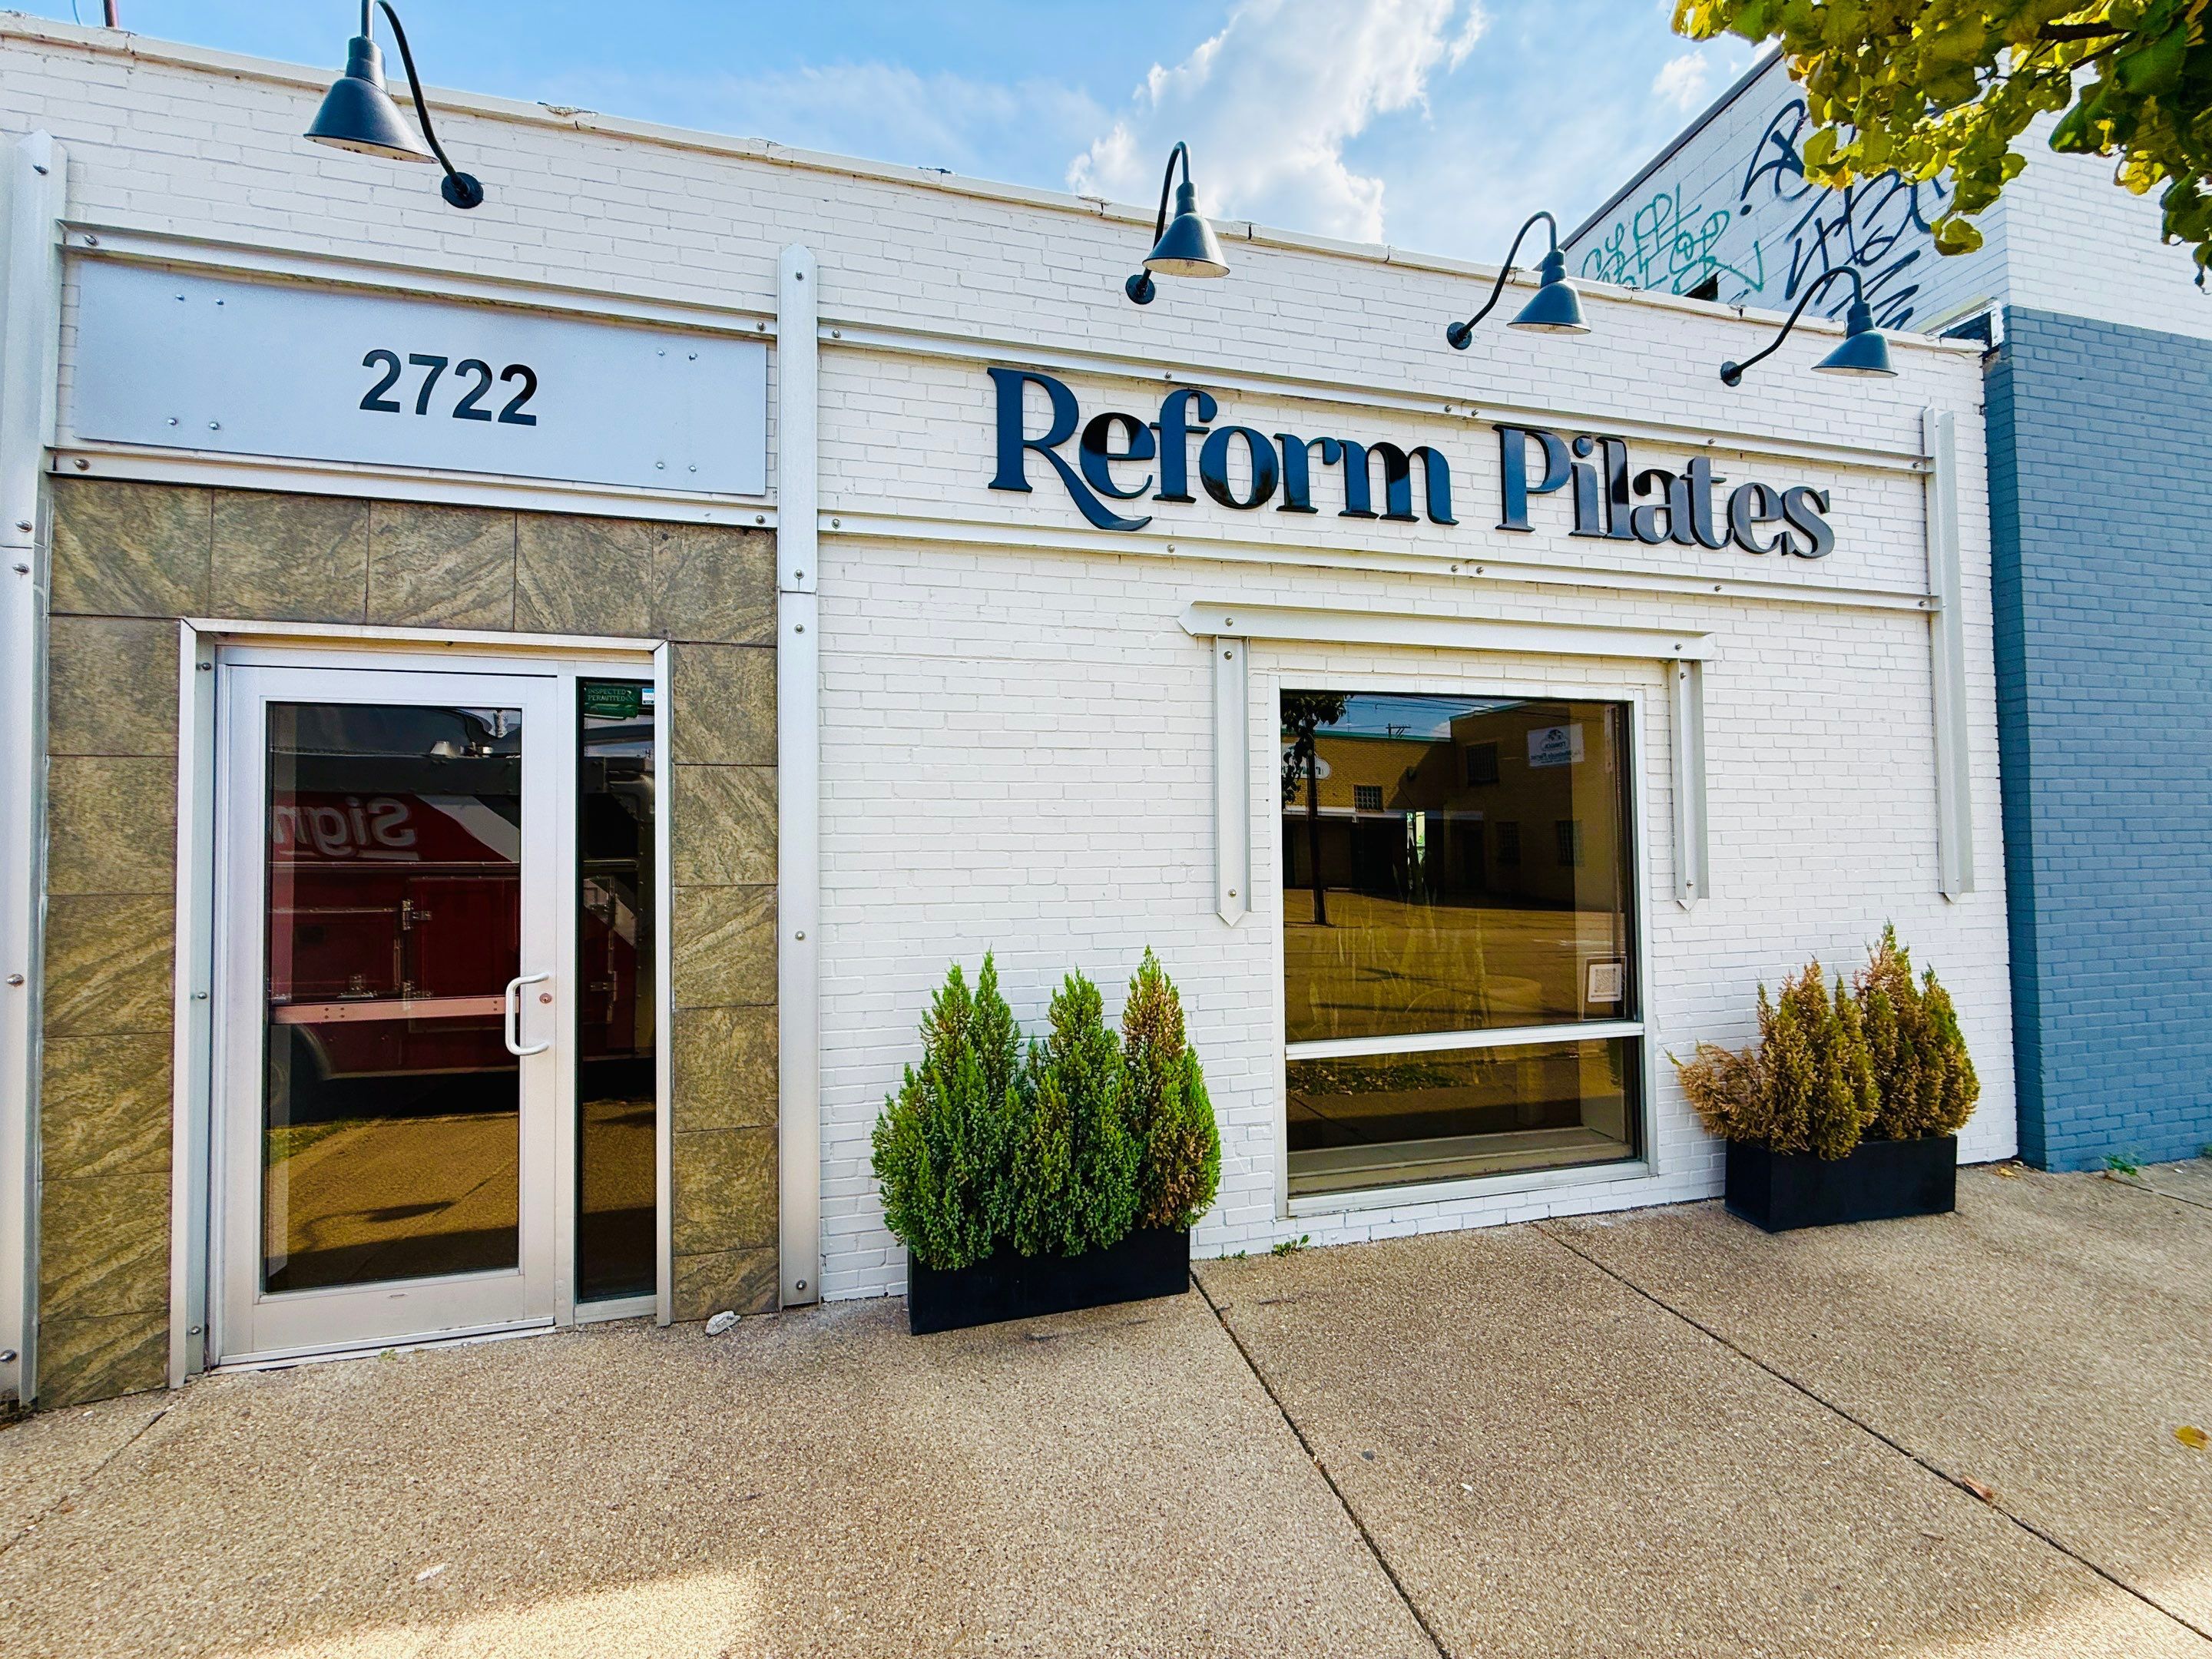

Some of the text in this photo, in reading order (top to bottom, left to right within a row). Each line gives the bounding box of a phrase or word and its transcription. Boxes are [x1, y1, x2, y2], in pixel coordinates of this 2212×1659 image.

[359, 349, 538, 427] 2722
[987, 367, 1835, 558] Reform Pilates
